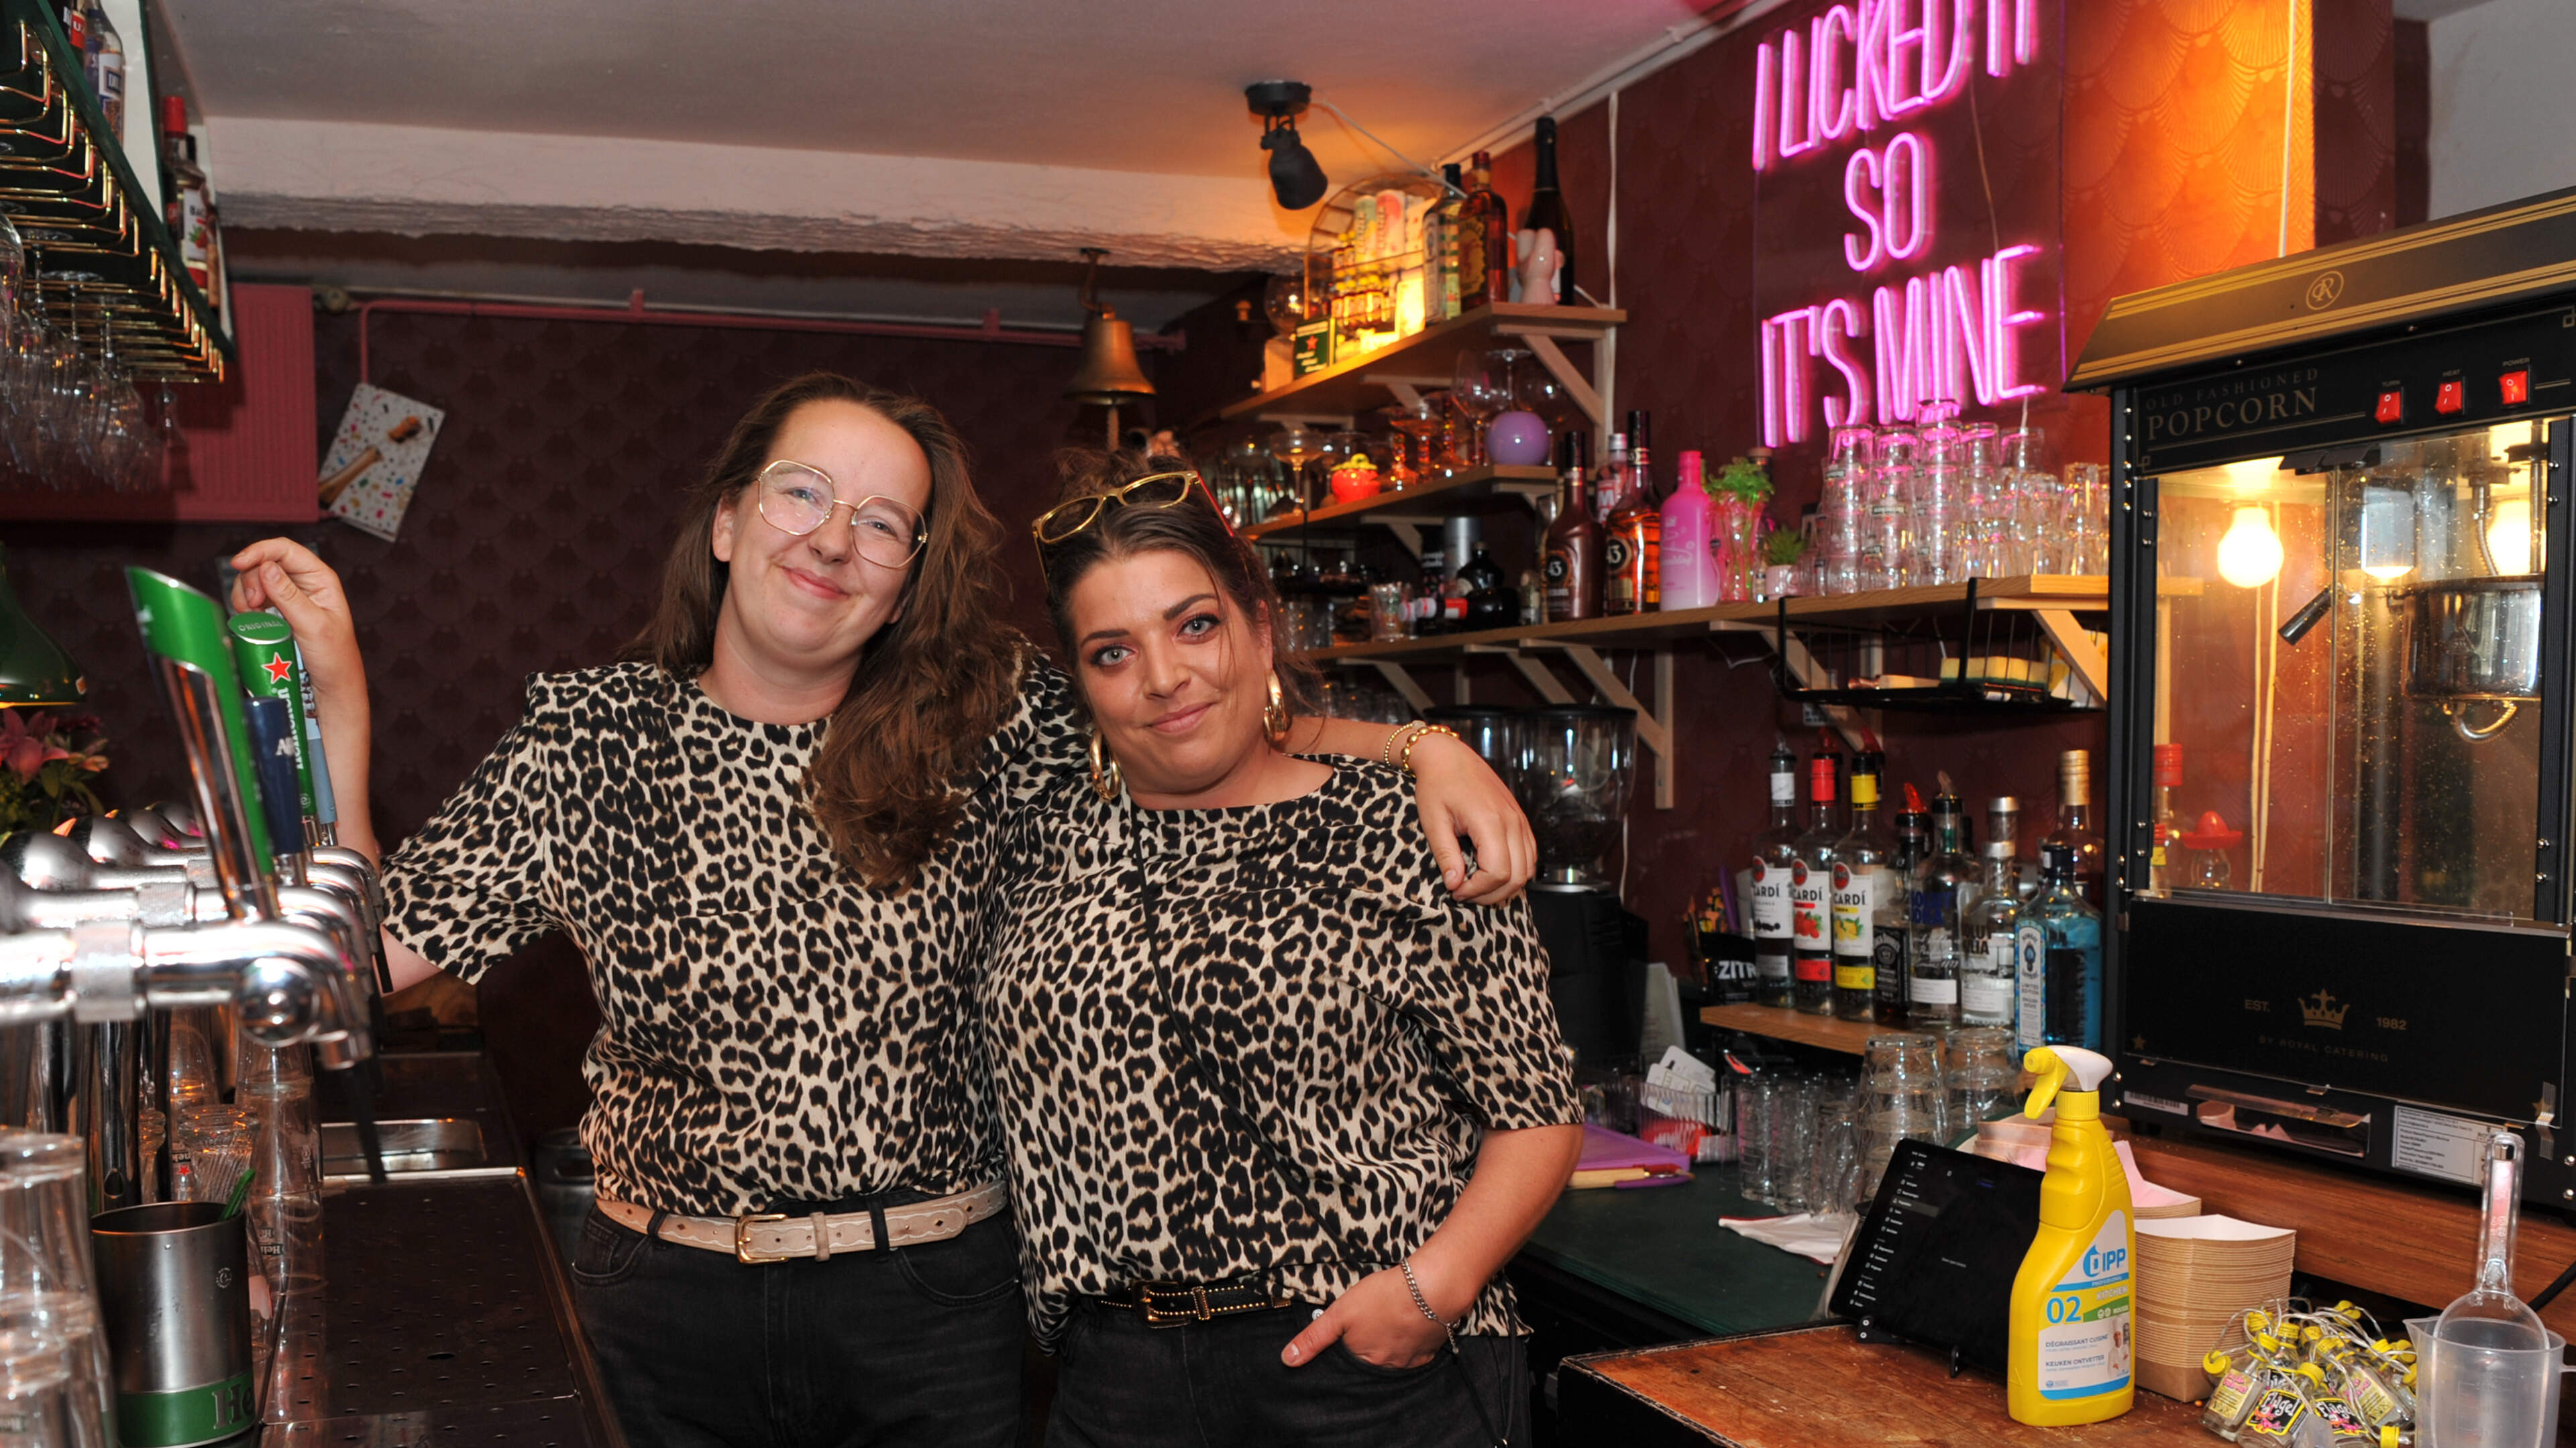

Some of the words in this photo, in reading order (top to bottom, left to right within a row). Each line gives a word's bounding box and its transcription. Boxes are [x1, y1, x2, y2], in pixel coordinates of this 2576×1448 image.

[1752, 42, 1772, 170] I
[1779, 0, 1970, 158] LICKED
[1843, 132, 1927, 272] SO
[1762, 298, 1860, 448] IT'S
[1873, 244, 2043, 425] MINE
[2443, 368, 2461, 378] HEAT
[2502, 357, 2530, 368] POWER
[2147, 390, 2184, 410] OLD
[2196, 367, 2319, 402] FASHIONED
[2381, 379, 2402, 388] TURN
[2149, 387, 2318, 441] POPCORN
[2244, 999, 2271, 1013] EST.
[2376, 1016, 2407, 1031] 1982
[2259, 1035, 2273, 1044] BY
[2279, 1038, 2318, 1052] ROYAL
[2324, 1046, 2388, 1062] CATERING
[2083, 1245, 2127, 1278] DIPP
[2096, 1284, 2129, 1301] KITCHEN
[2046, 1296, 2082, 1325] 02
[2045, 1359, 2072, 1368] KEUKEN
[2073, 1354, 2105, 1366] ONTVETTER
